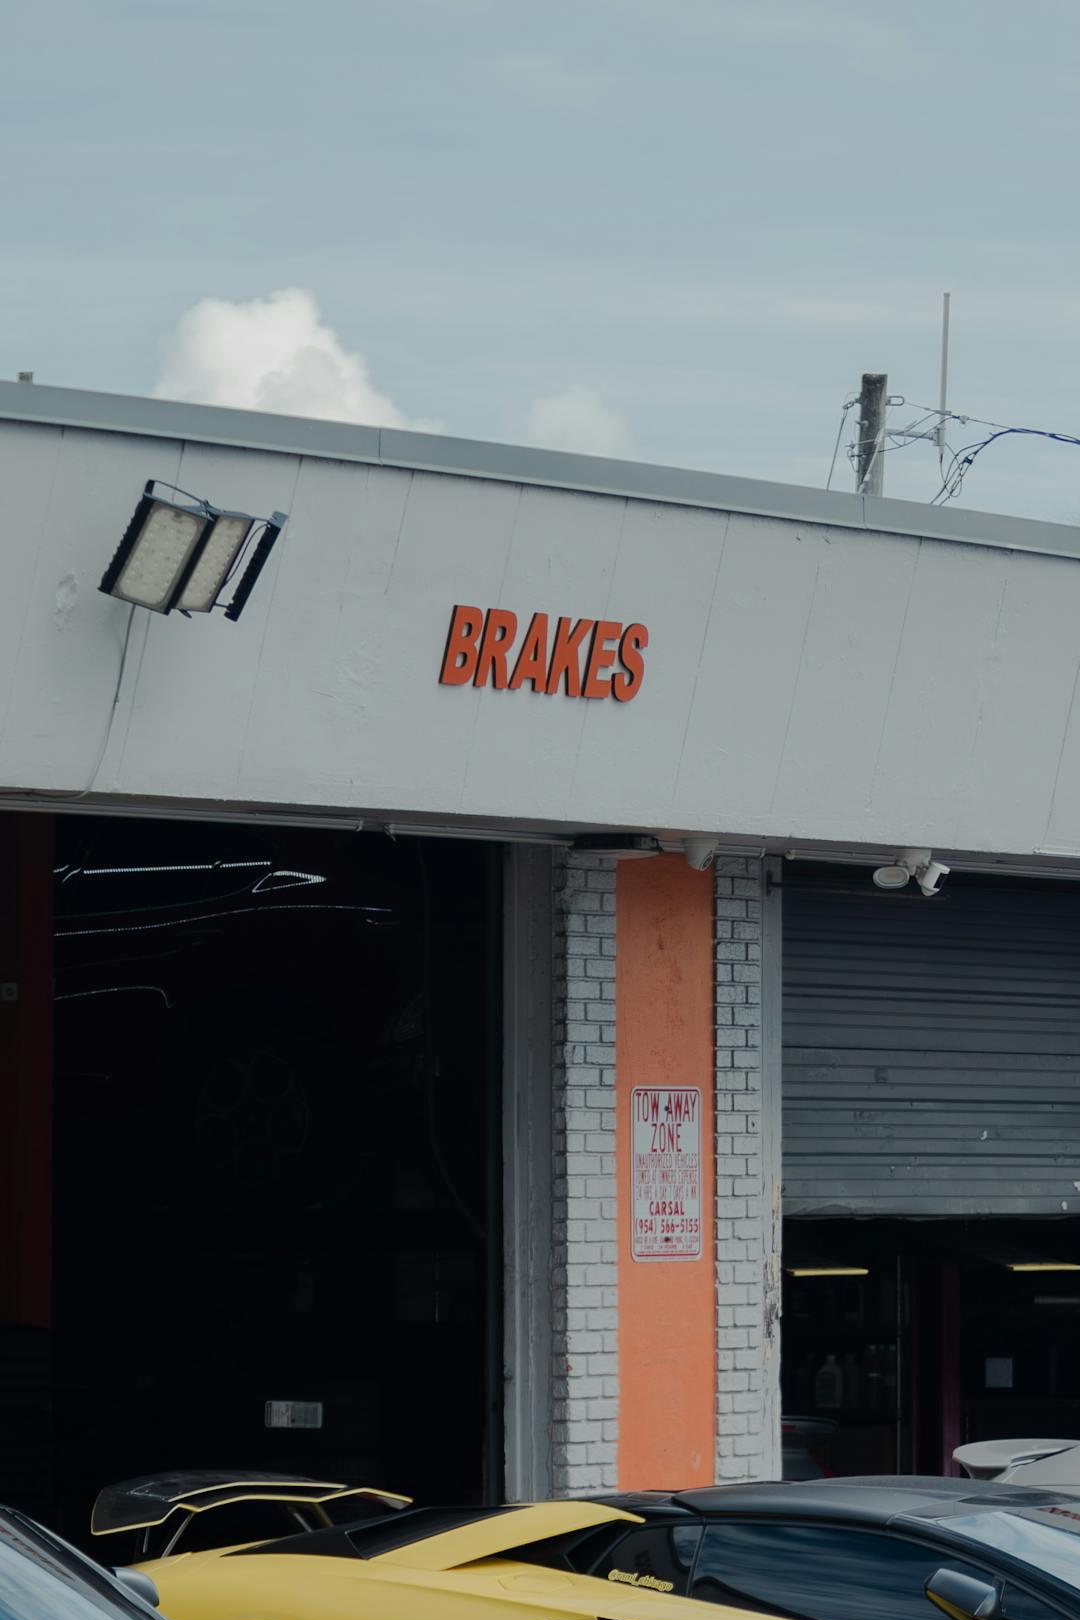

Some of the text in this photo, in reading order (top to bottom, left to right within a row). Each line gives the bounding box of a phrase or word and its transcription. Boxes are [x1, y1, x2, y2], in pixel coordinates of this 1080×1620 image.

[439, 605, 649, 702] BRAKES
[636, 1092, 697, 1122] TOW AWAY
[651, 1122, 682, 1153] ZONE
[649, 1201, 685, 1216] CARSAL
[635, 1217, 699, 1235] (954) 566-5155
